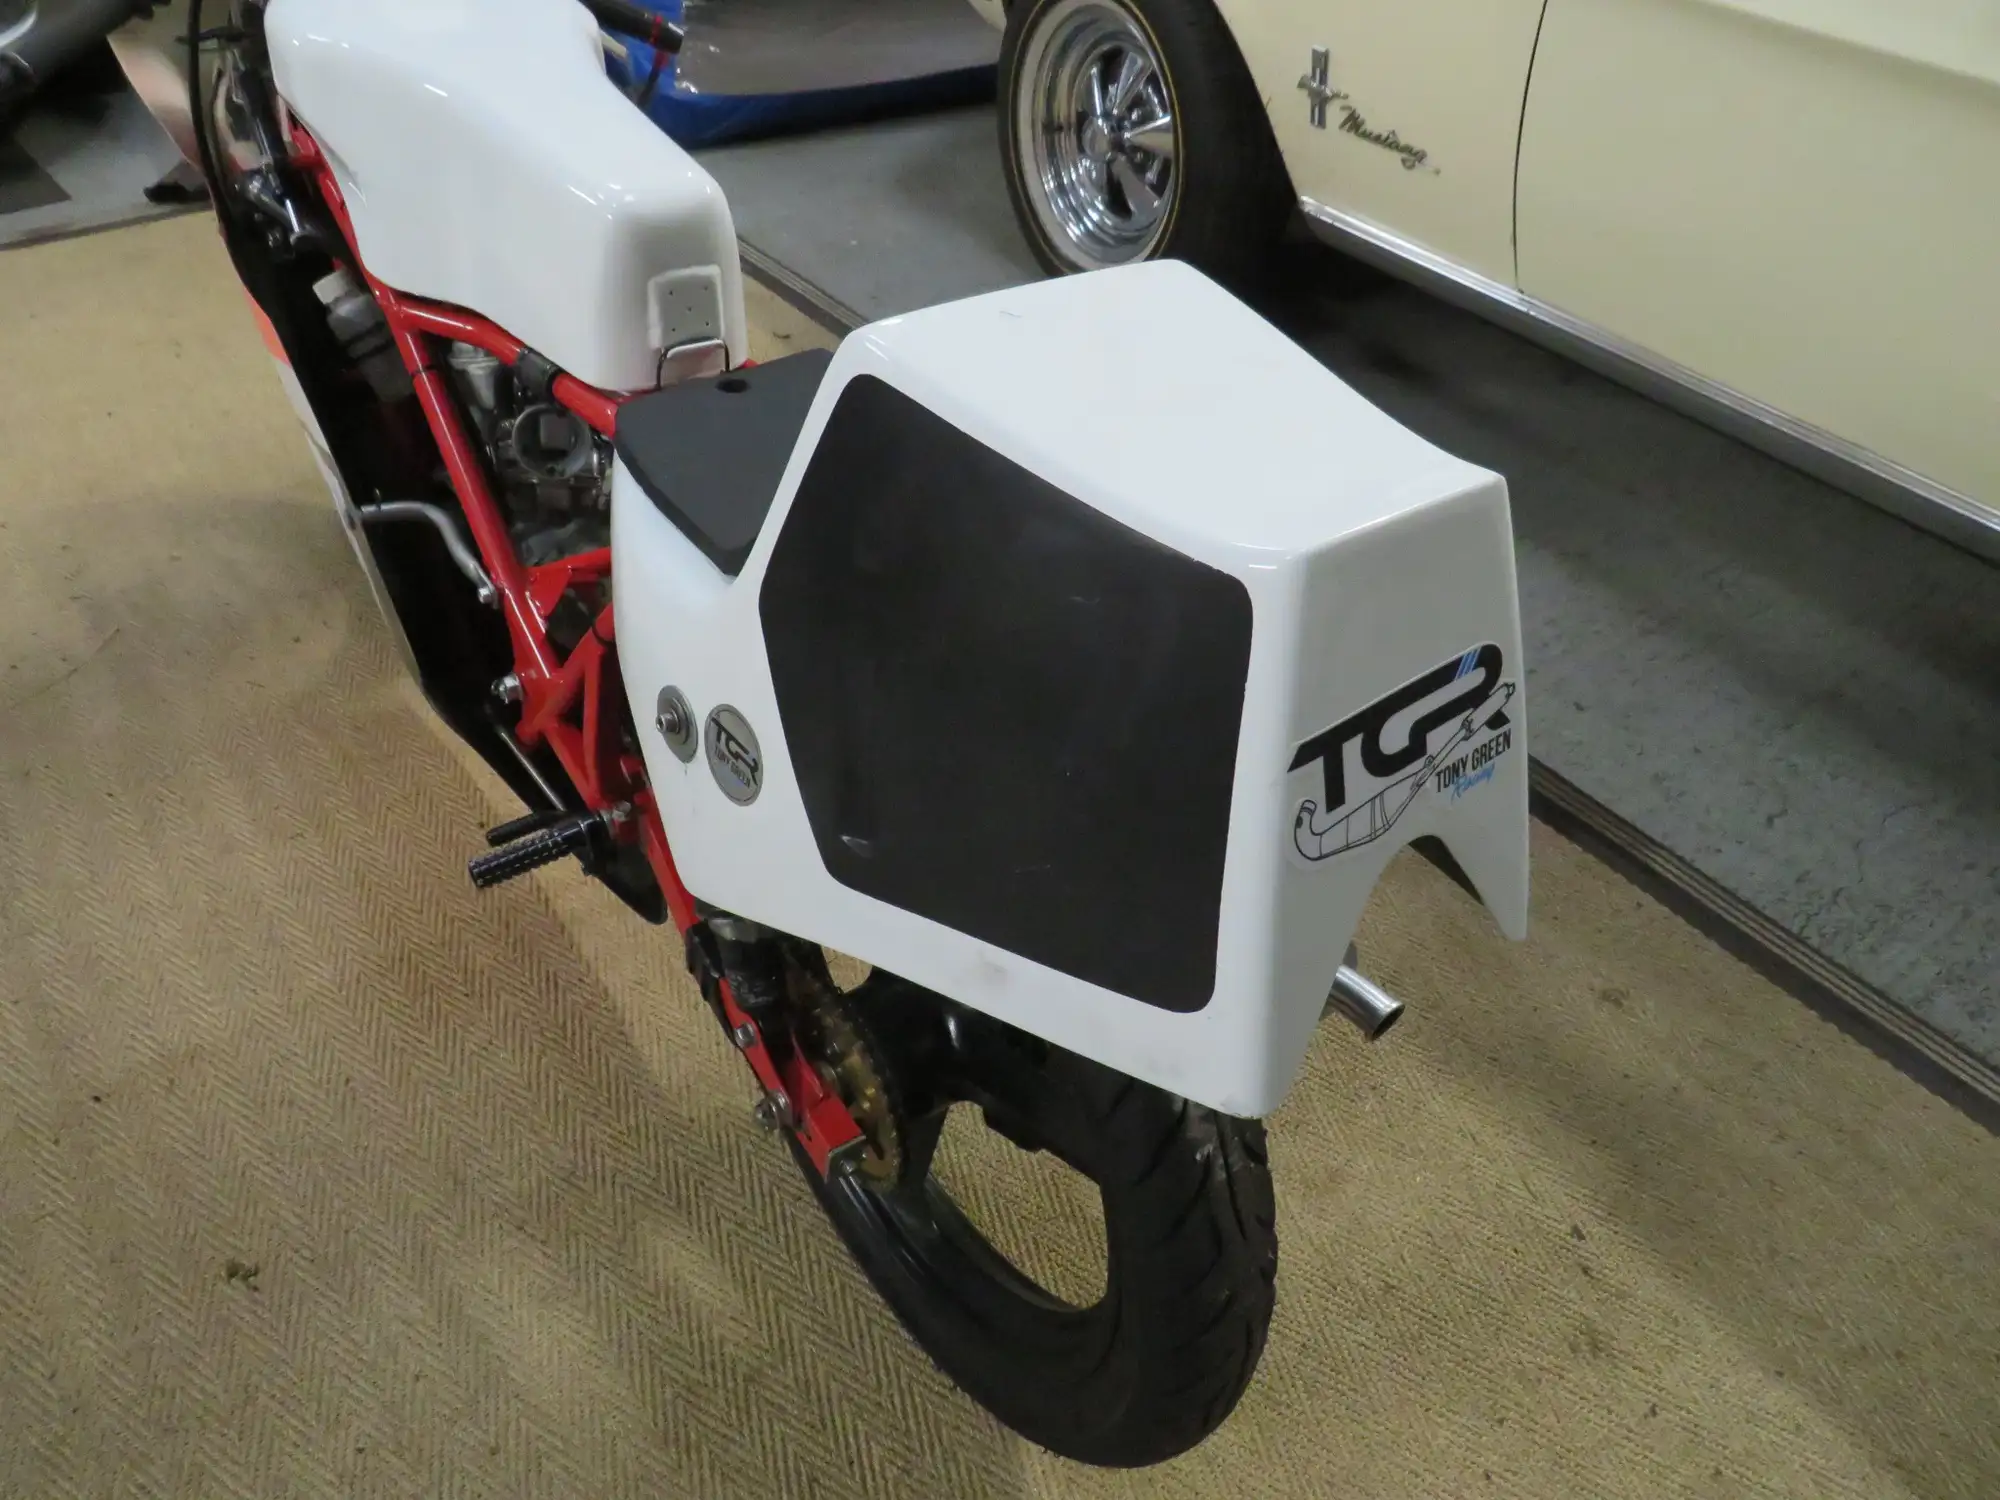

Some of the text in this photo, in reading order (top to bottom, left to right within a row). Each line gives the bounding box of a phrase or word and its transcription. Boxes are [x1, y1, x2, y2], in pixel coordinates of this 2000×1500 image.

[1338, 104, 1440, 174] Mustang
[1435, 728, 1512, 793] TONY GREEN
